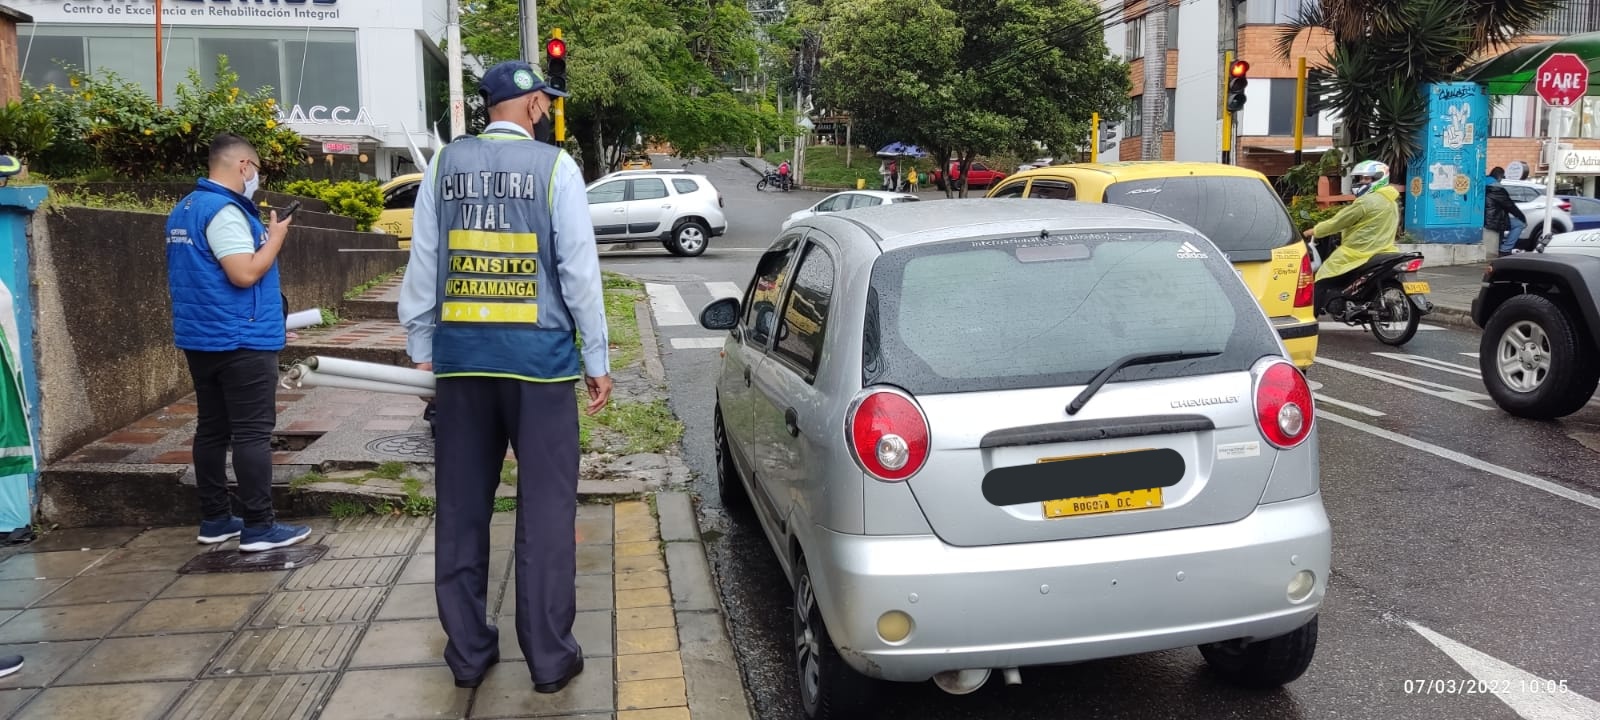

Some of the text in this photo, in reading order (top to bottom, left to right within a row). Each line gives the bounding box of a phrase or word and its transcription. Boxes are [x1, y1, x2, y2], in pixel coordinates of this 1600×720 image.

[63, 3, 340, 21] Centro de Excelncia en Rehabilitación Integral
[1542, 72, 1582, 89] PARE
[441, 171, 536, 201] CULTURA
[461, 203, 511, 230] VIAL
[451, 255, 536, 274] RANSITO
[446, 279, 535, 297] UCARAMANGA
[1170, 395, 1240, 409] CHEVROLET
[1073, 500, 1110, 512] BOGOTA
